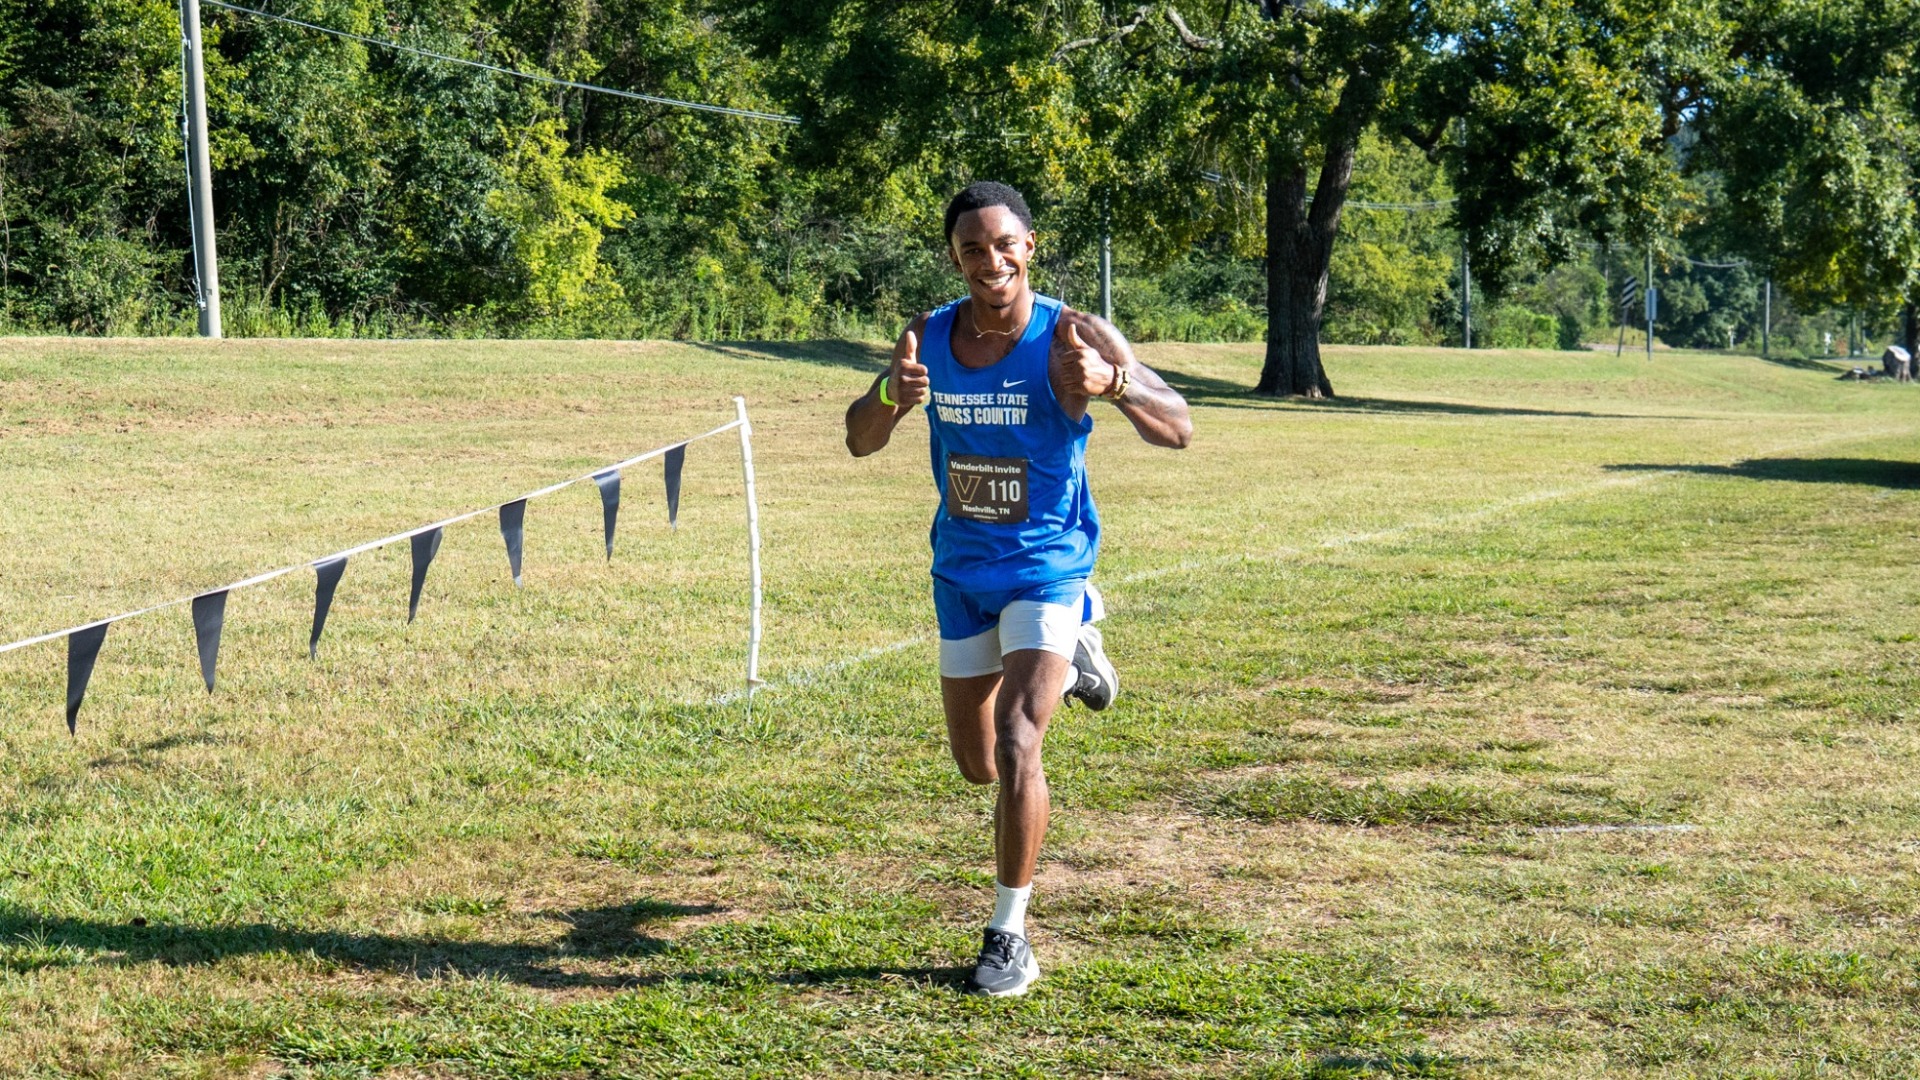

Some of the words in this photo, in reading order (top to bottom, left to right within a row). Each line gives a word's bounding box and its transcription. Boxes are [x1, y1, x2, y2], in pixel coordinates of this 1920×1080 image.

[933, 392, 995, 405] TENNESSEE
[996, 393, 1029, 406] STATE
[937, 405, 972, 424] CROSS
[974, 407, 1027, 425] COUNTRY
[951, 461, 994, 473] Vanderbilt
[994, 465, 1021, 474] Invite
[949, 473, 982, 502] V
[988, 480, 1020, 502] 110
[962, 504, 998, 515] Nashville,
[998, 507, 1010, 515] TN
